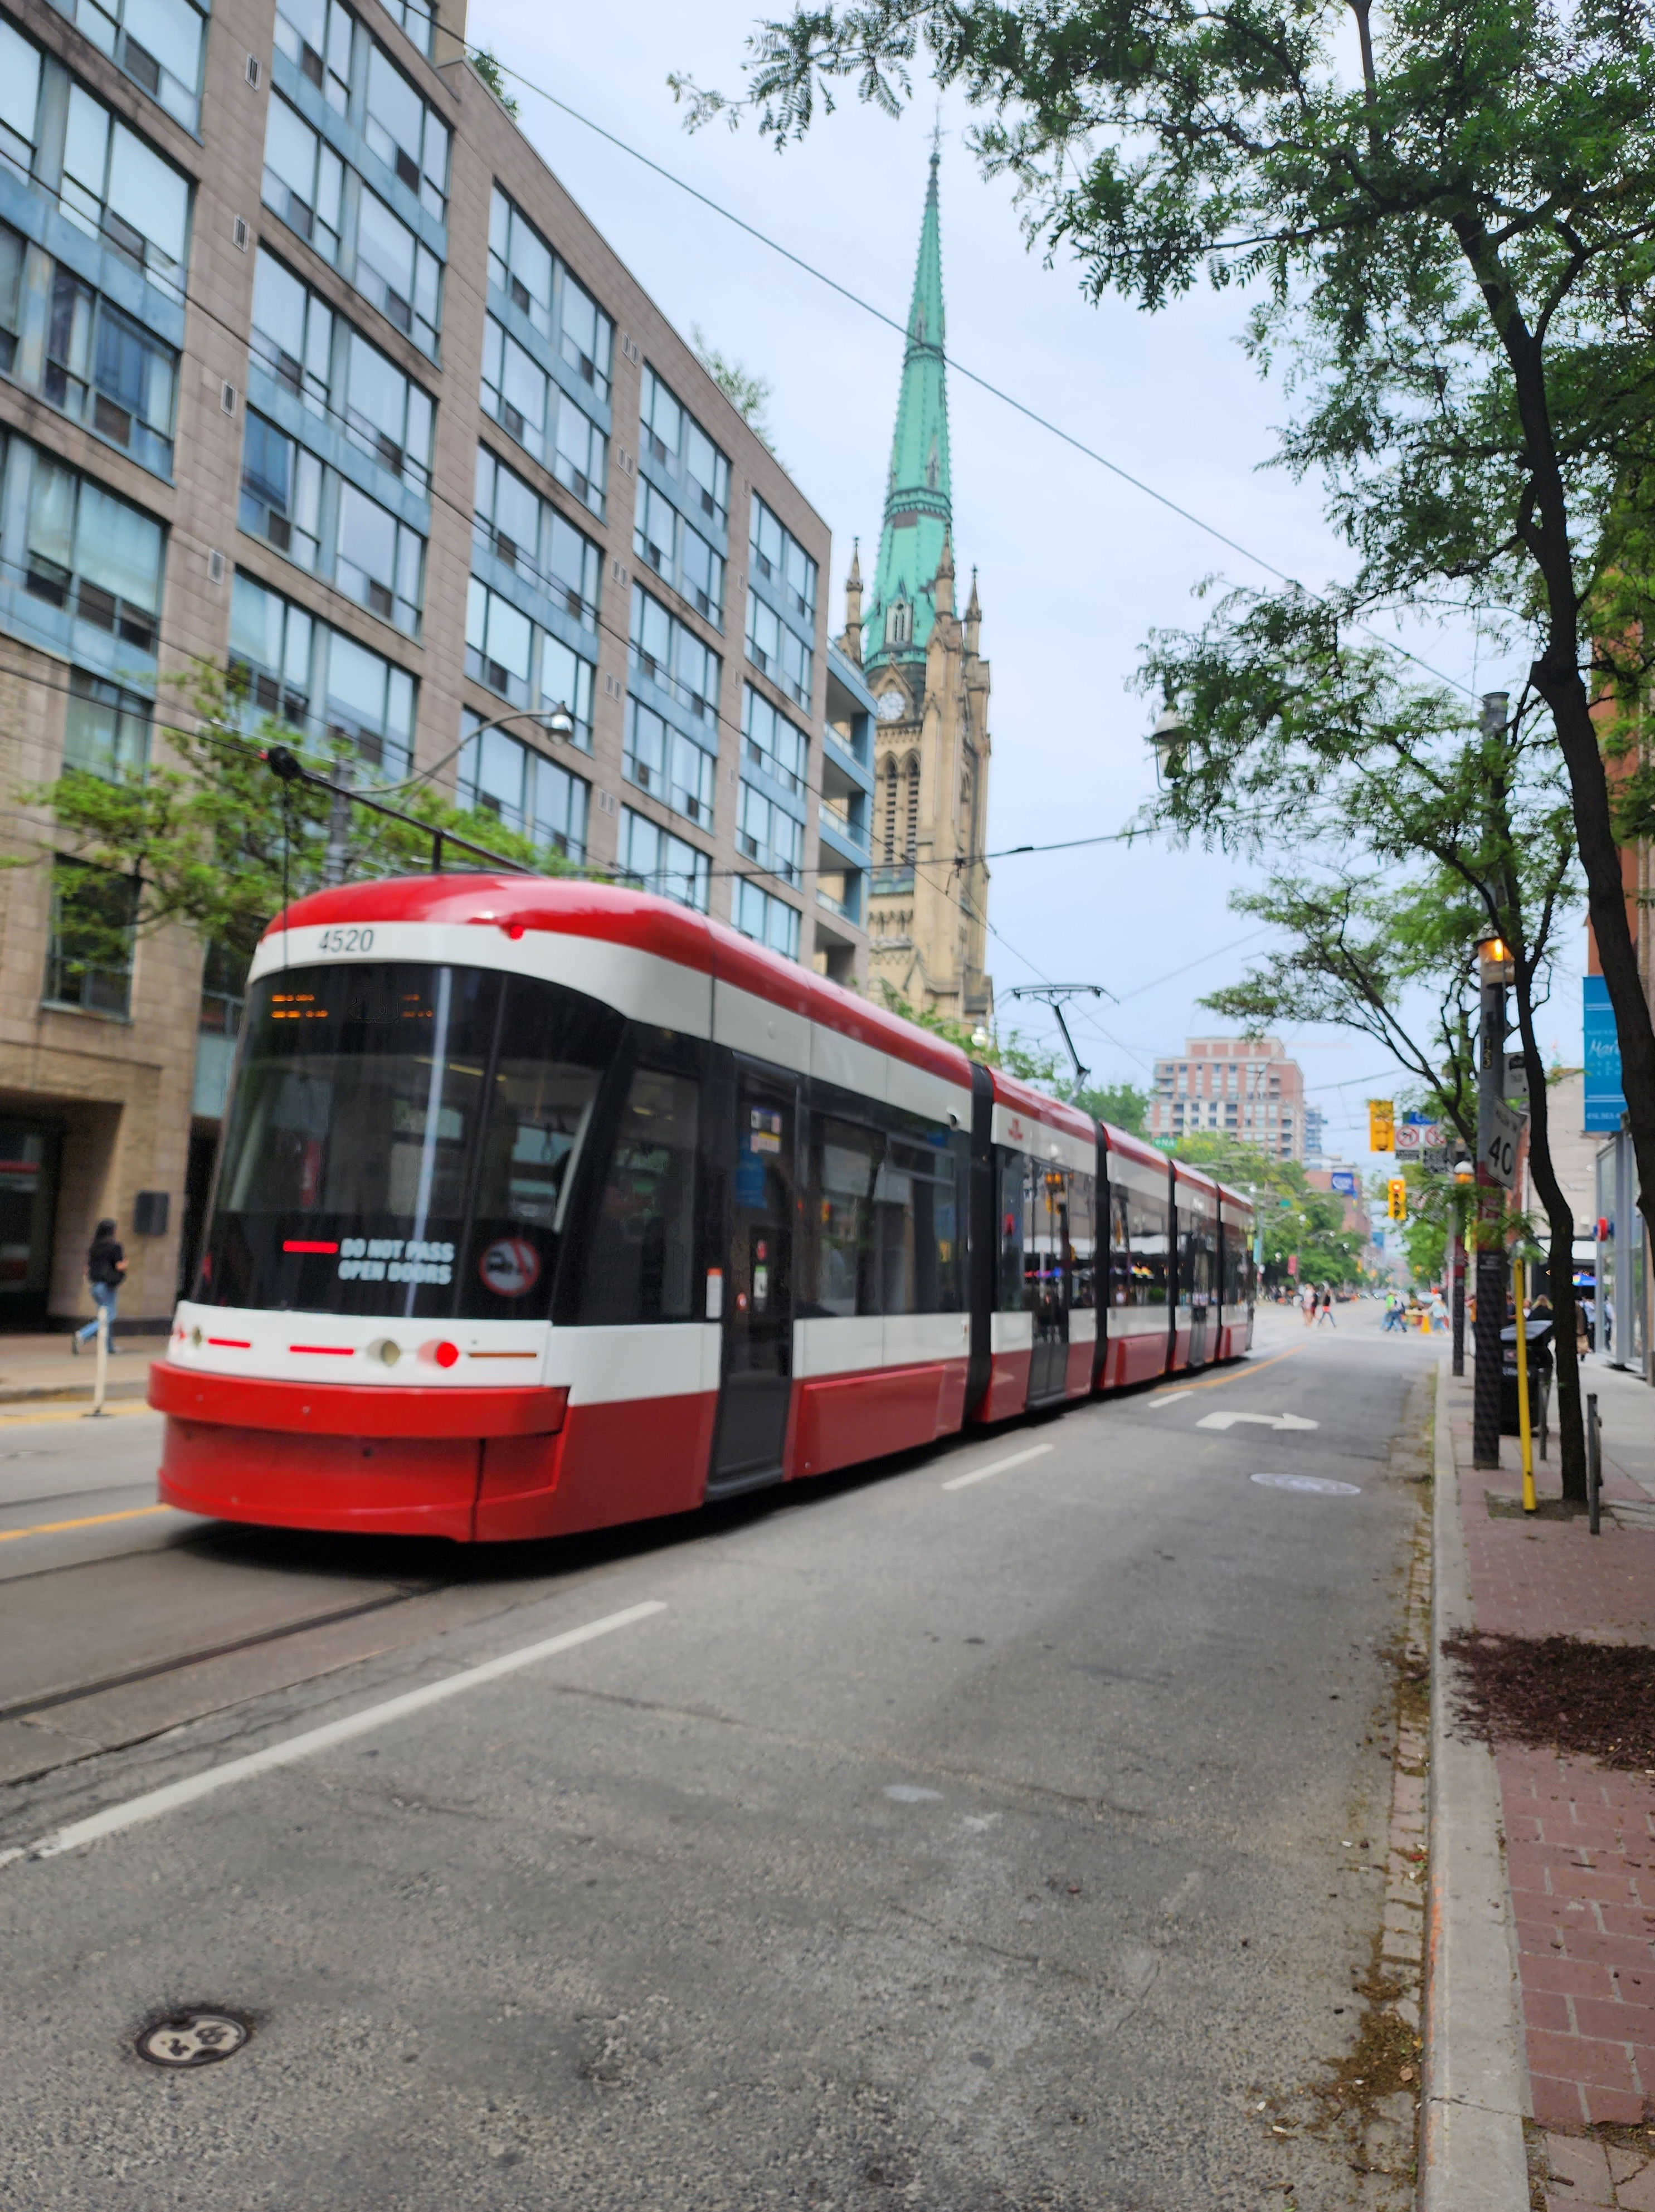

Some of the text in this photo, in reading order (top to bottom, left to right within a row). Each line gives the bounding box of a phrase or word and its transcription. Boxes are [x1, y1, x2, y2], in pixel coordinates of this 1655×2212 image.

[317, 929, 374, 952] 4520
[1488, 1134, 1514, 1176] 40
[340, 1237, 455, 1263] DO NOT PASS
[338, 1259, 452, 1285] OPEN DOORS
